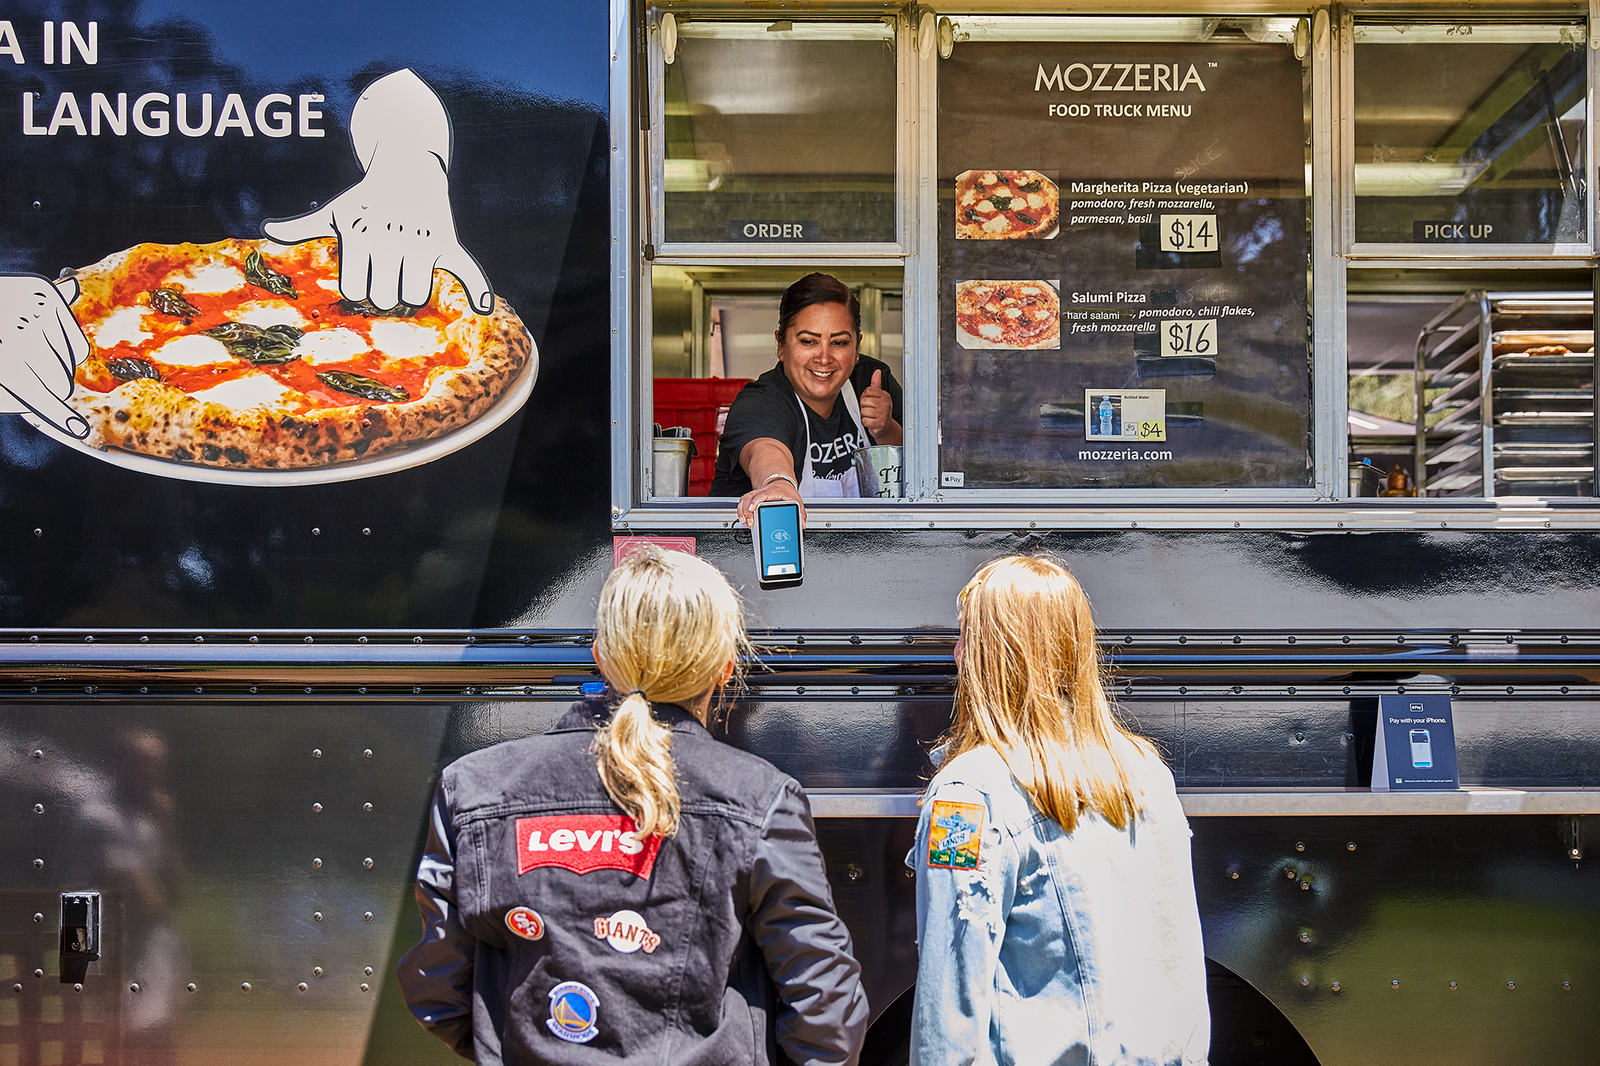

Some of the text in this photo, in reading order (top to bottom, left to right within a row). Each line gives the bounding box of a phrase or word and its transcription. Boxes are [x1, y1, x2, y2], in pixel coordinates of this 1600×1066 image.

[43, 20, 98, 65] IN
[1034, 62, 1206, 93] MOZZERIA
[22, 91, 326, 138] LANGUAGE
[1048, 104, 1192, 118] FOOD TRUCK MENU
[1071, 181, 1249, 196] Margherita Pizza (vegetarian)
[1070, 198, 1216, 211] pomodoro, fresh mozzarella,
[1070, 213, 1152, 226] parmesan, basil
[742, 223, 804, 239] ORDER
[1168, 217, 1214, 250] $14
[1423, 224, 1494, 239] PICK UP
[1071, 291, 1147, 304] Salumi Pizza
[1066, 311, 1120, 321] hard salami
[1138, 306, 1256, 319] pomodoro, chili flakes,
[1070, 322, 1156, 335] fresh mozzarella
[1168, 322, 1211, 354] $16
[1140, 421, 1162, 438] $4
[1077, 448, 1173, 462] mozzeria.com
[950, 475, 962, 484] Pay
[1389, 717, 1400, 725] Pay
[595, 918, 660, 952] GIANTS
